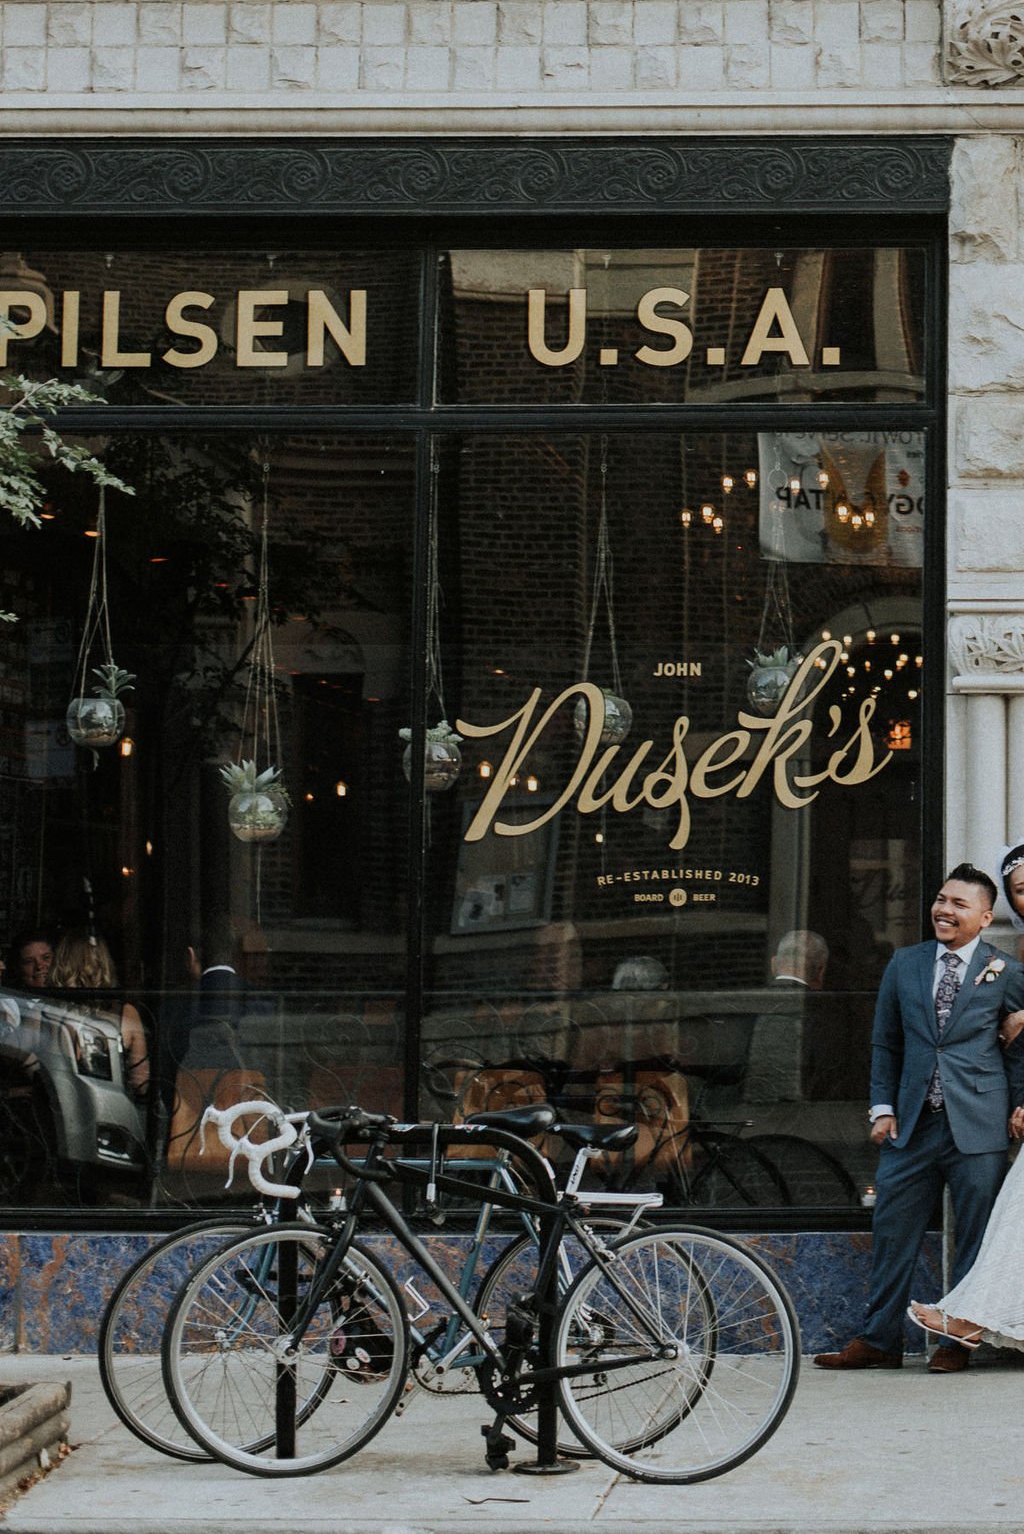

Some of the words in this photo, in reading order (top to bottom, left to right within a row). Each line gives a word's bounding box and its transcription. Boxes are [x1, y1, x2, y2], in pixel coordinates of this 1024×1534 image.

[0, 289, 368, 368] PILSEN
[527, 287, 841, 367] U.S.A.
[653, 662, 702, 677] JOHN
[455, 639, 894, 851] Dusek's
[596, 869, 723, 887] RE-ESTABLISHED
[728, 872, 760, 886] 2013
[634, 893, 665, 902] BOARD
[692, 893, 716, 902] BEER
